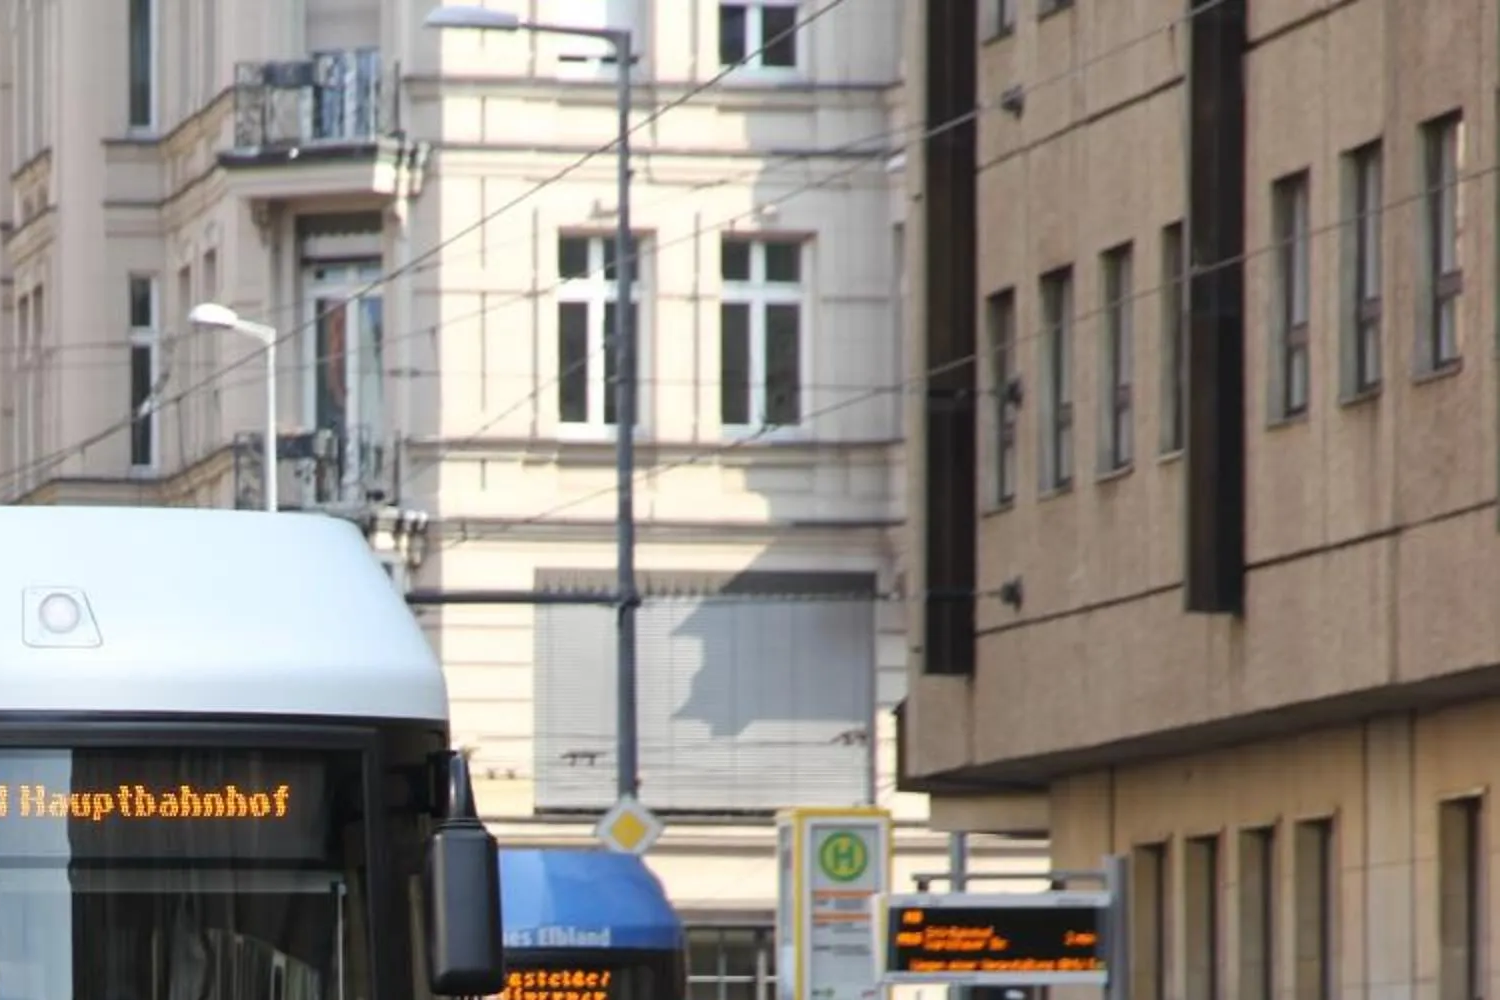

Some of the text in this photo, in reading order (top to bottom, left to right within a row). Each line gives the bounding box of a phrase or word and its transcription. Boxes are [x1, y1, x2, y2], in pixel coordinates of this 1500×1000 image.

[19, 784, 290, 821] Hauptbahnhof
[833, 844, 856, 872] H
[538, 925, 612, 947] Elbland
